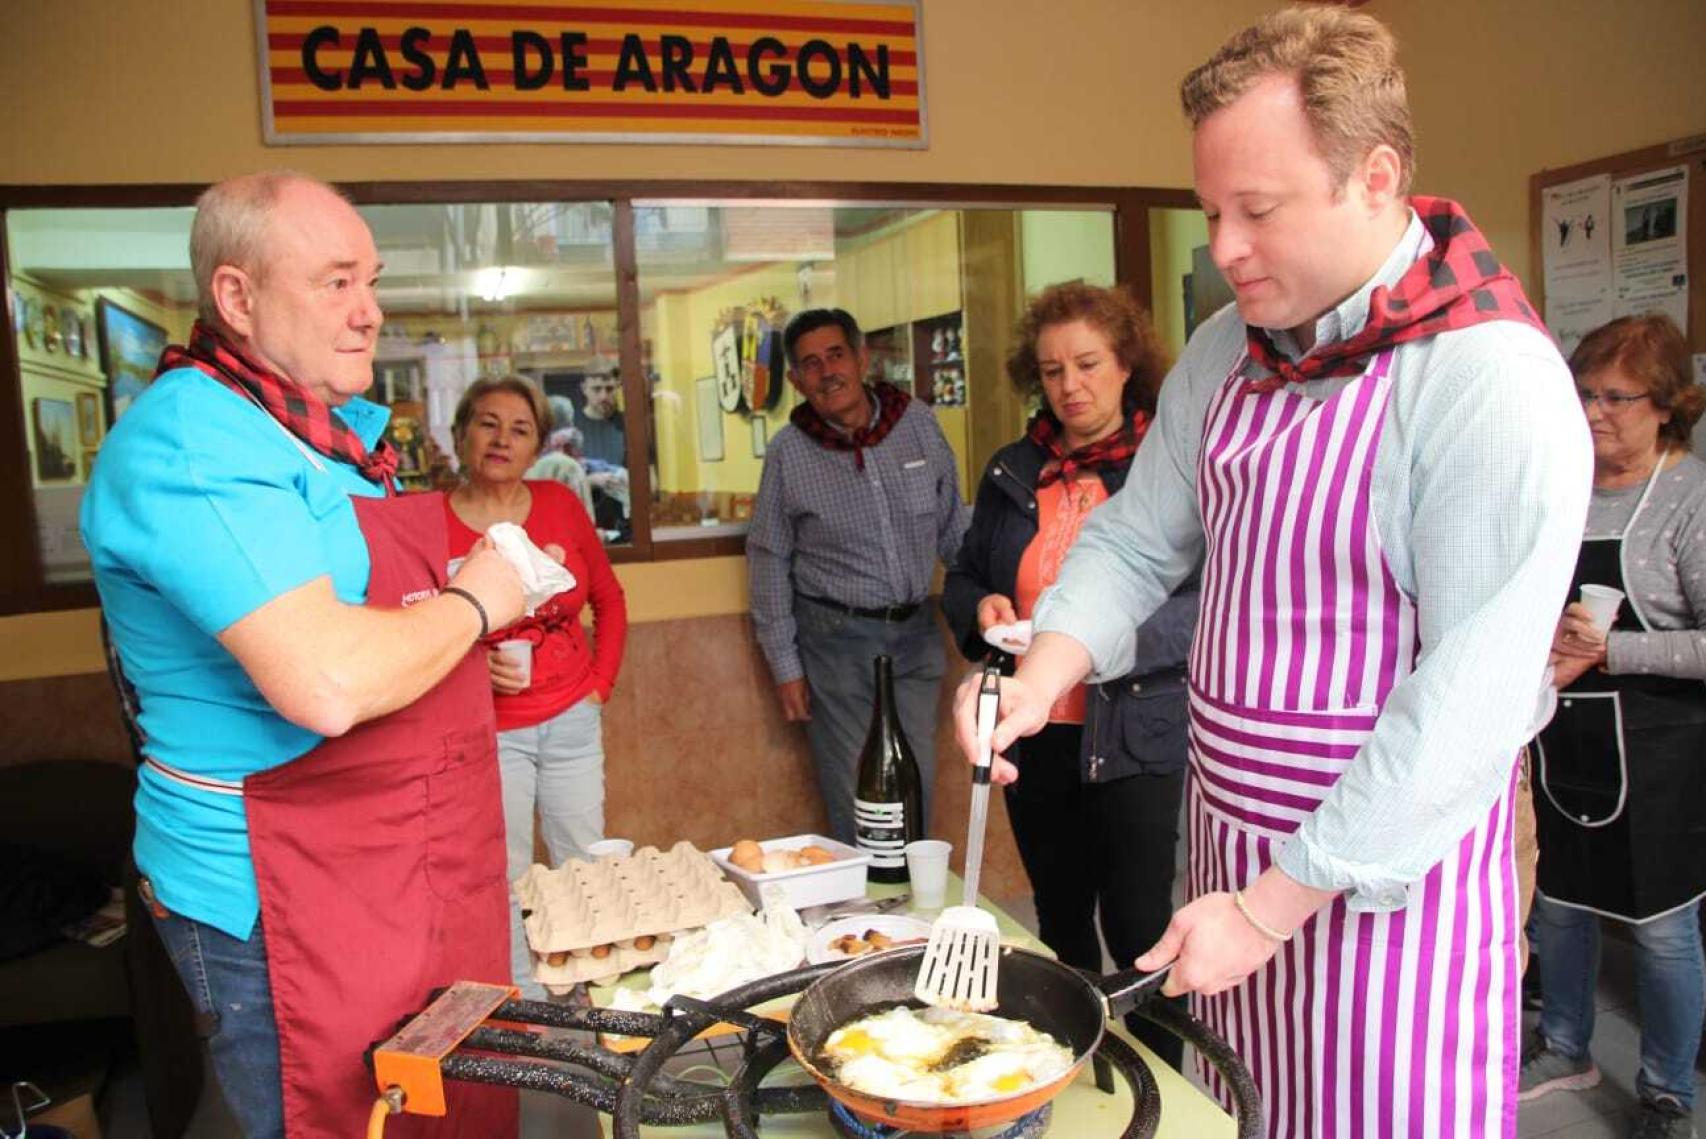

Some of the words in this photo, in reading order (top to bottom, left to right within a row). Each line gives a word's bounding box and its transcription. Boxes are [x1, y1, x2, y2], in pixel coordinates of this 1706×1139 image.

[300, 25, 489, 91] CASA
[511, 31, 590, 91] DE
[611, 34, 891, 100] ARAGON
